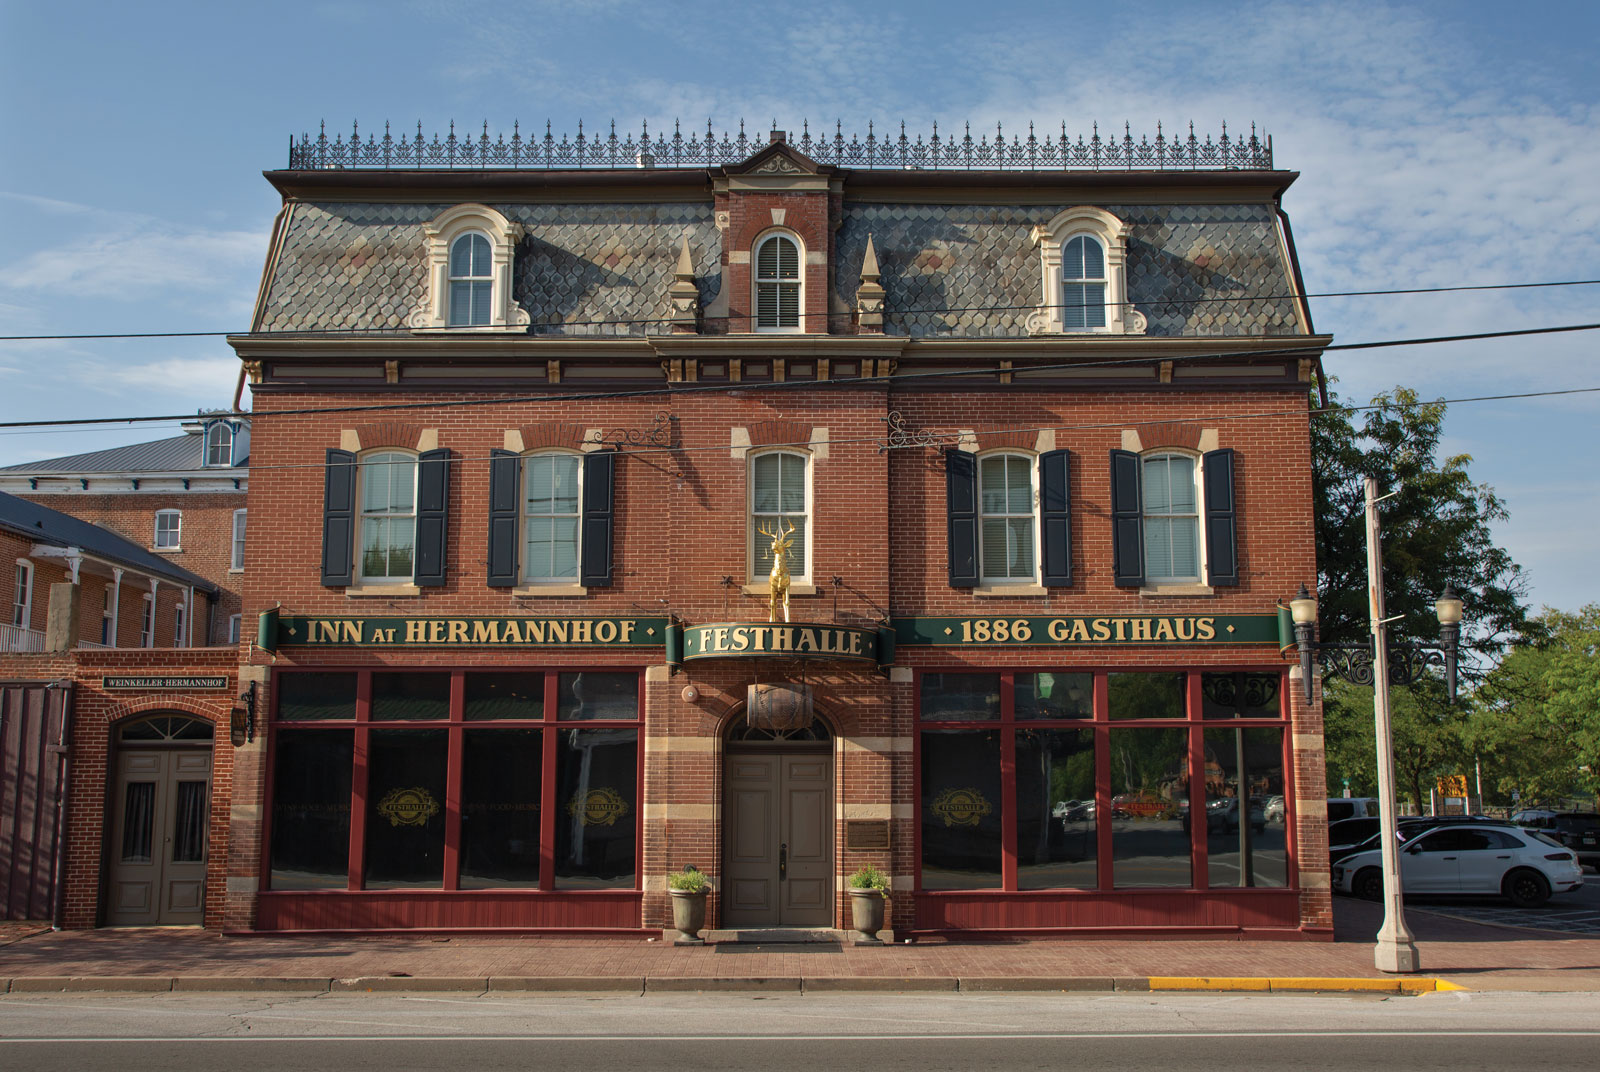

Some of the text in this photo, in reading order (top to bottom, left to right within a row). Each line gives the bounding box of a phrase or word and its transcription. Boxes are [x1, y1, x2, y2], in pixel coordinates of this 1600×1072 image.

[306, 620, 636, 643] INN AT HERMANNHOF
[698, 627, 863, 655] FESTHALLE
[960, 618, 1216, 643] 1886 GASTHAUS
